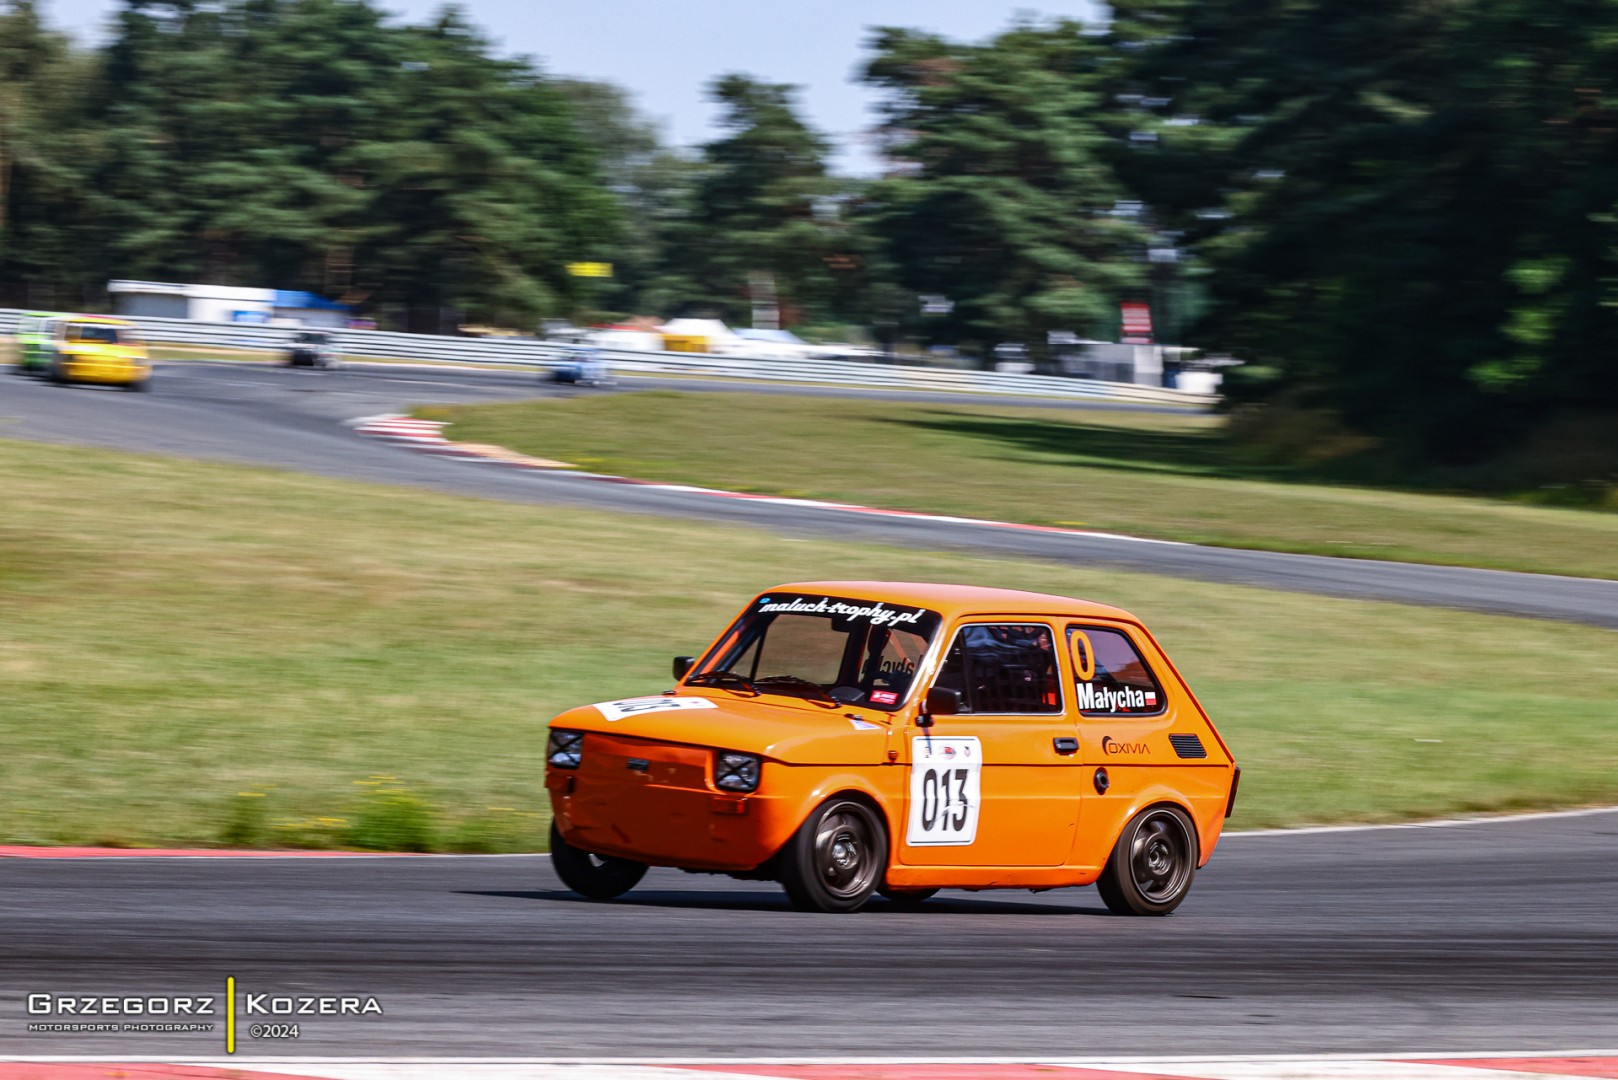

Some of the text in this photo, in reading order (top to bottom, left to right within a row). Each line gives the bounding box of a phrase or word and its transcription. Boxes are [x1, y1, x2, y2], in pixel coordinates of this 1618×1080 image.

[758, 597, 926, 627] maluch-trophy.pl
[1070, 630, 1096, 681] 0
[1076, 682, 1145, 713] Małycha
[922, 768, 969, 832] 013
